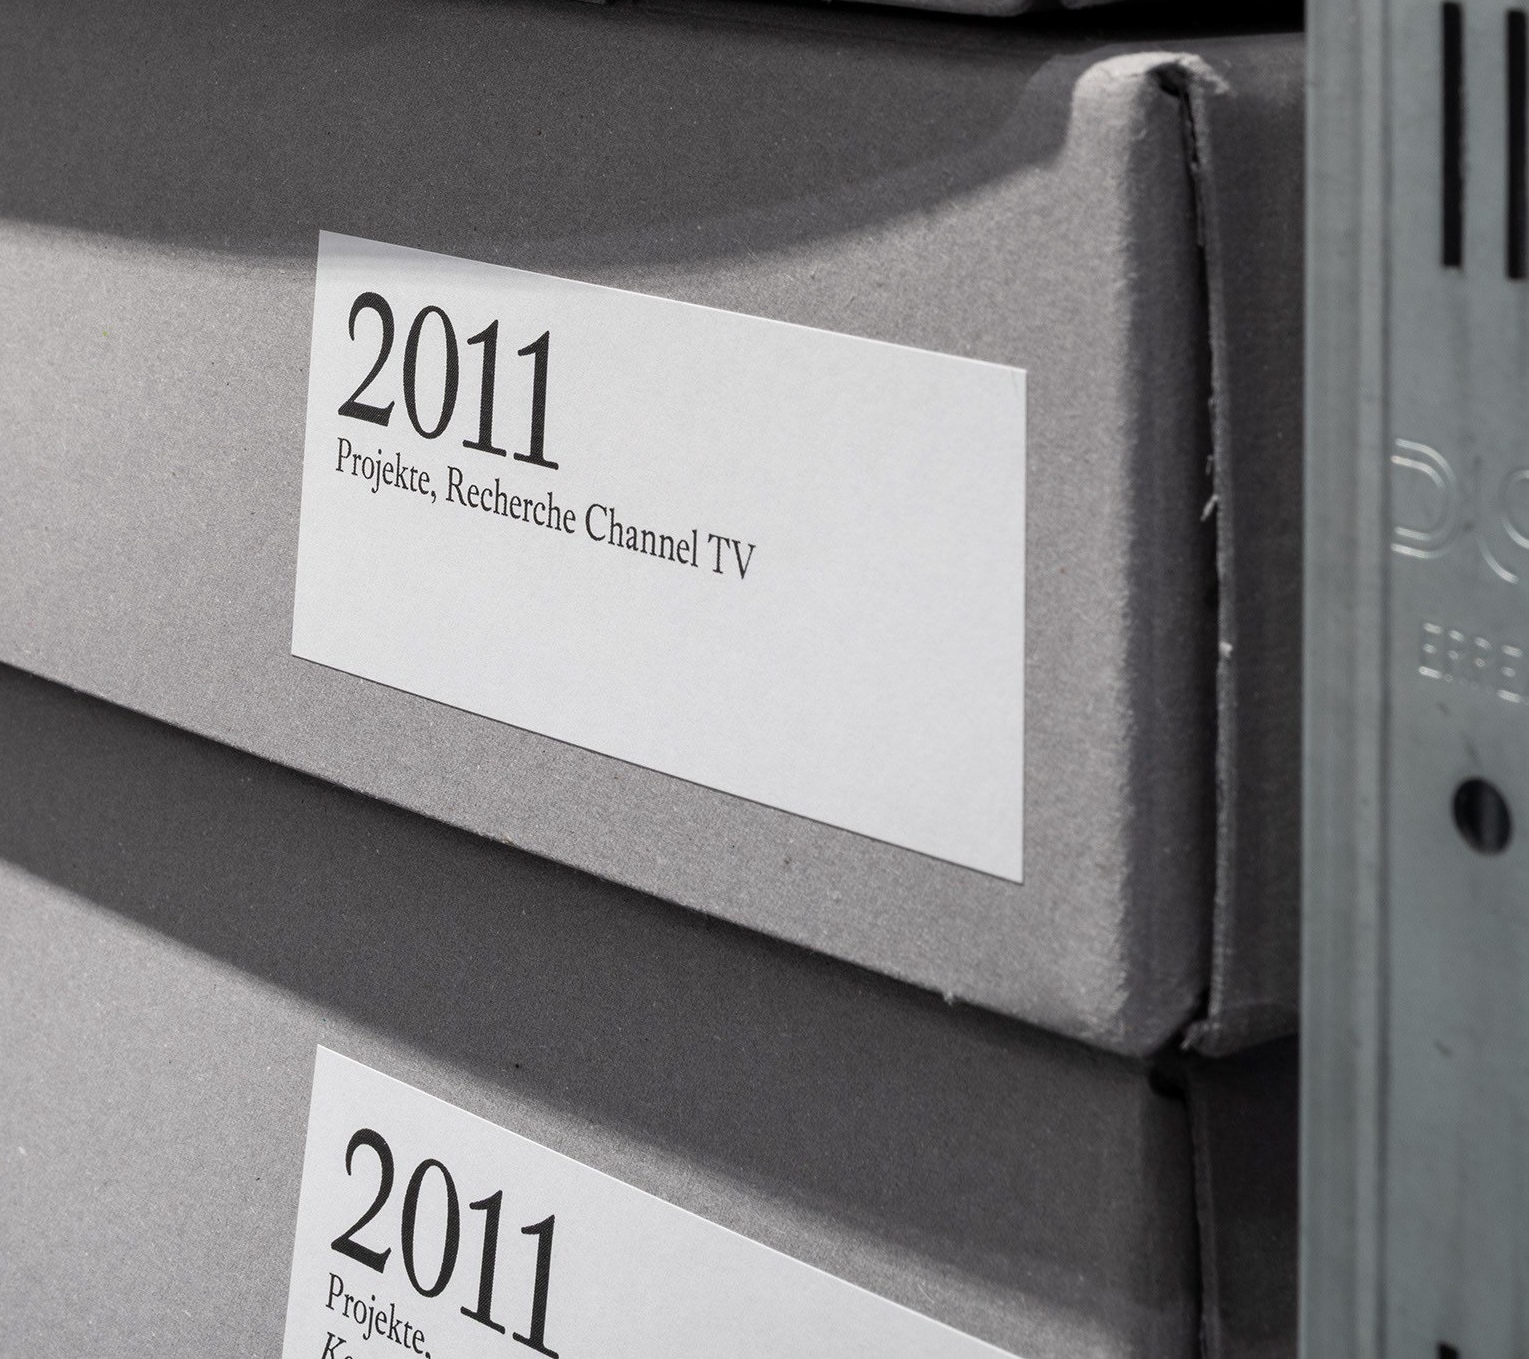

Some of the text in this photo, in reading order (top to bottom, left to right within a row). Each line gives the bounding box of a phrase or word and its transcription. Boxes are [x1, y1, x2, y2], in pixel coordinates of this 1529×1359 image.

[337, 290, 559, 471] 2011
[334, 437, 757, 581] Projekte, Recherche Channel TV
[325, 1271, 434, 1359] Projekte,
[330, 1127, 560, 1359] 2011
